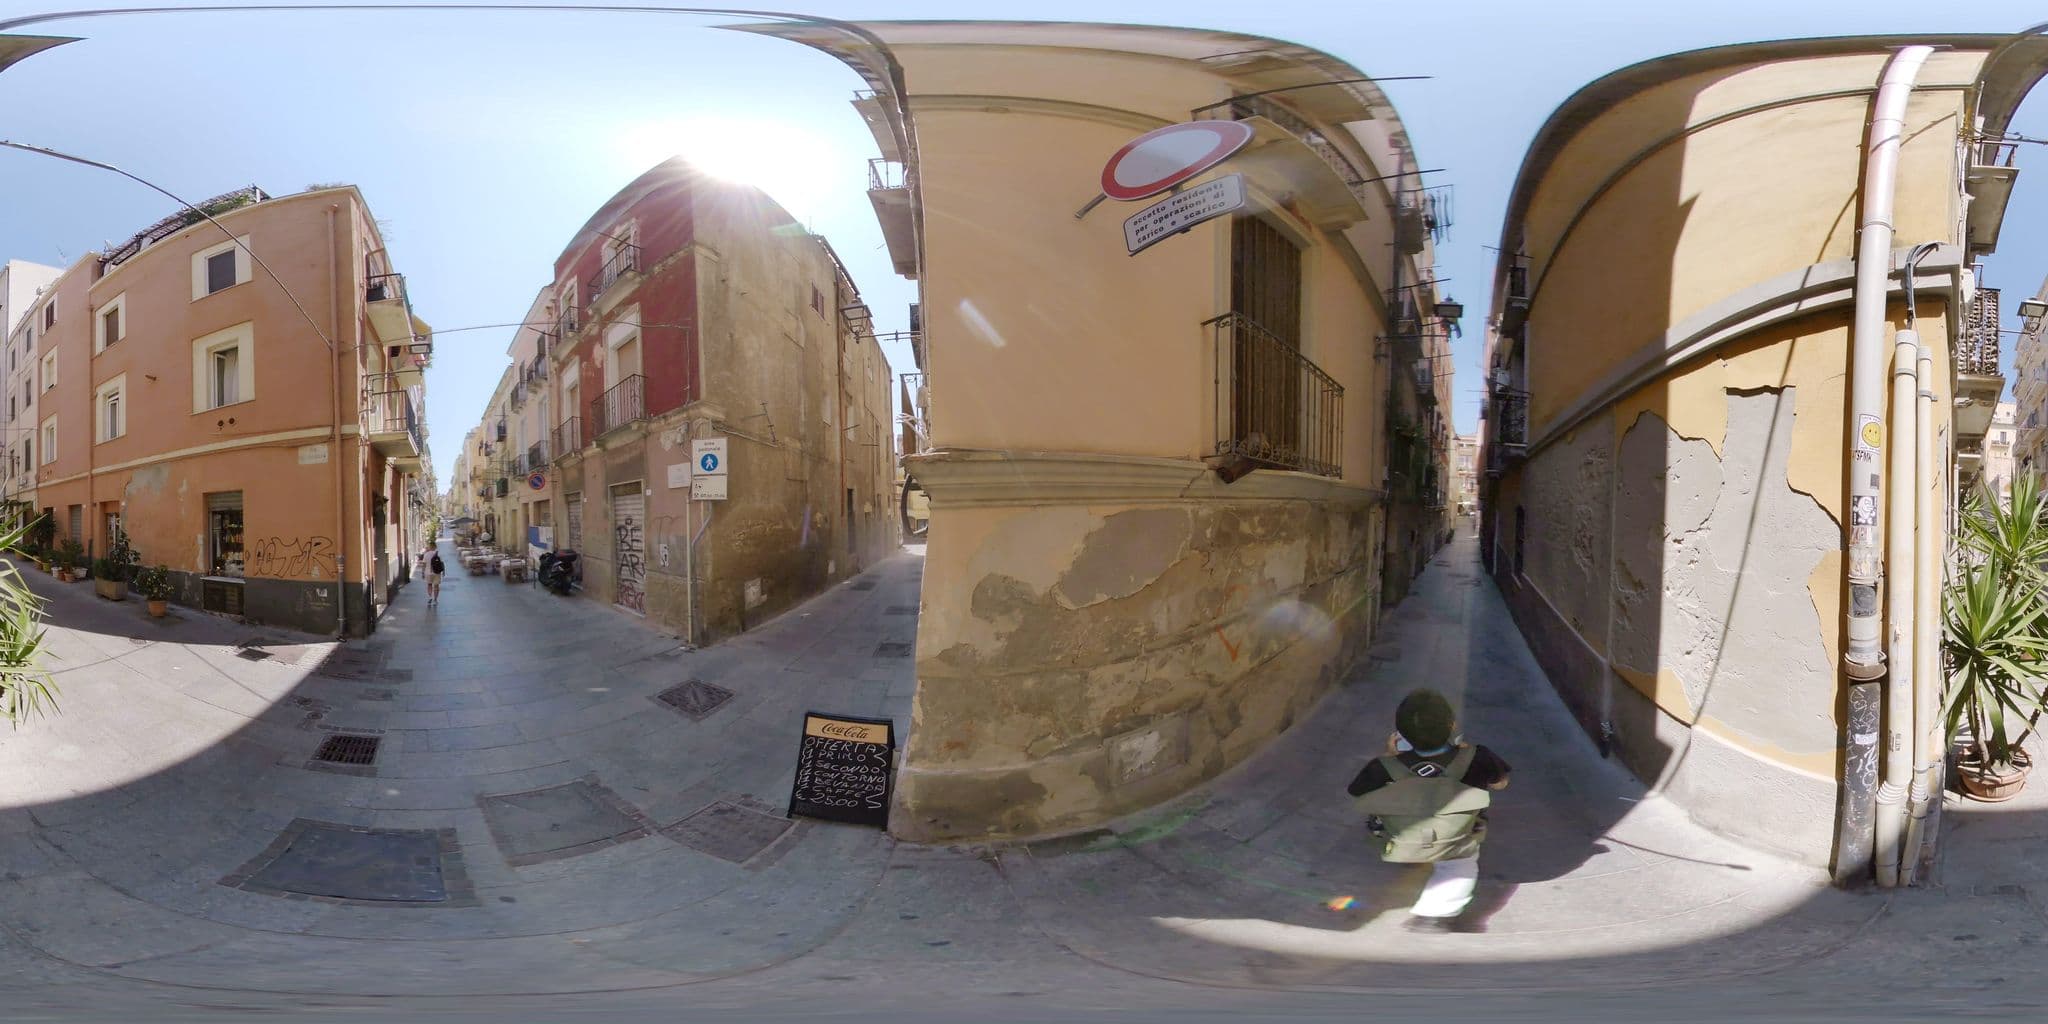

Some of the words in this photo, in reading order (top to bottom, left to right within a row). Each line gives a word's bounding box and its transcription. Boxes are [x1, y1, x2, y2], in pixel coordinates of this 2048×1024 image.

[1133, 206, 1166, 226] eccetto
[1172, 183, 1224, 206] residenti
[1135, 225, 1148, 236] per
[1153, 198, 1206, 225] operazioni
[1214, 190, 1225, 199] di
[1137, 226, 1165, 243] carico
[1184, 201, 1226, 221] scarico
[805, 737, 876, 753] OFFERTA
[818, 750, 866, 762] PRIMO
[816, 760, 880, 773] SECONDO
[814, 771, 884, 783] CONTORNO
[815, 777, 883, 791] BEVANDA
